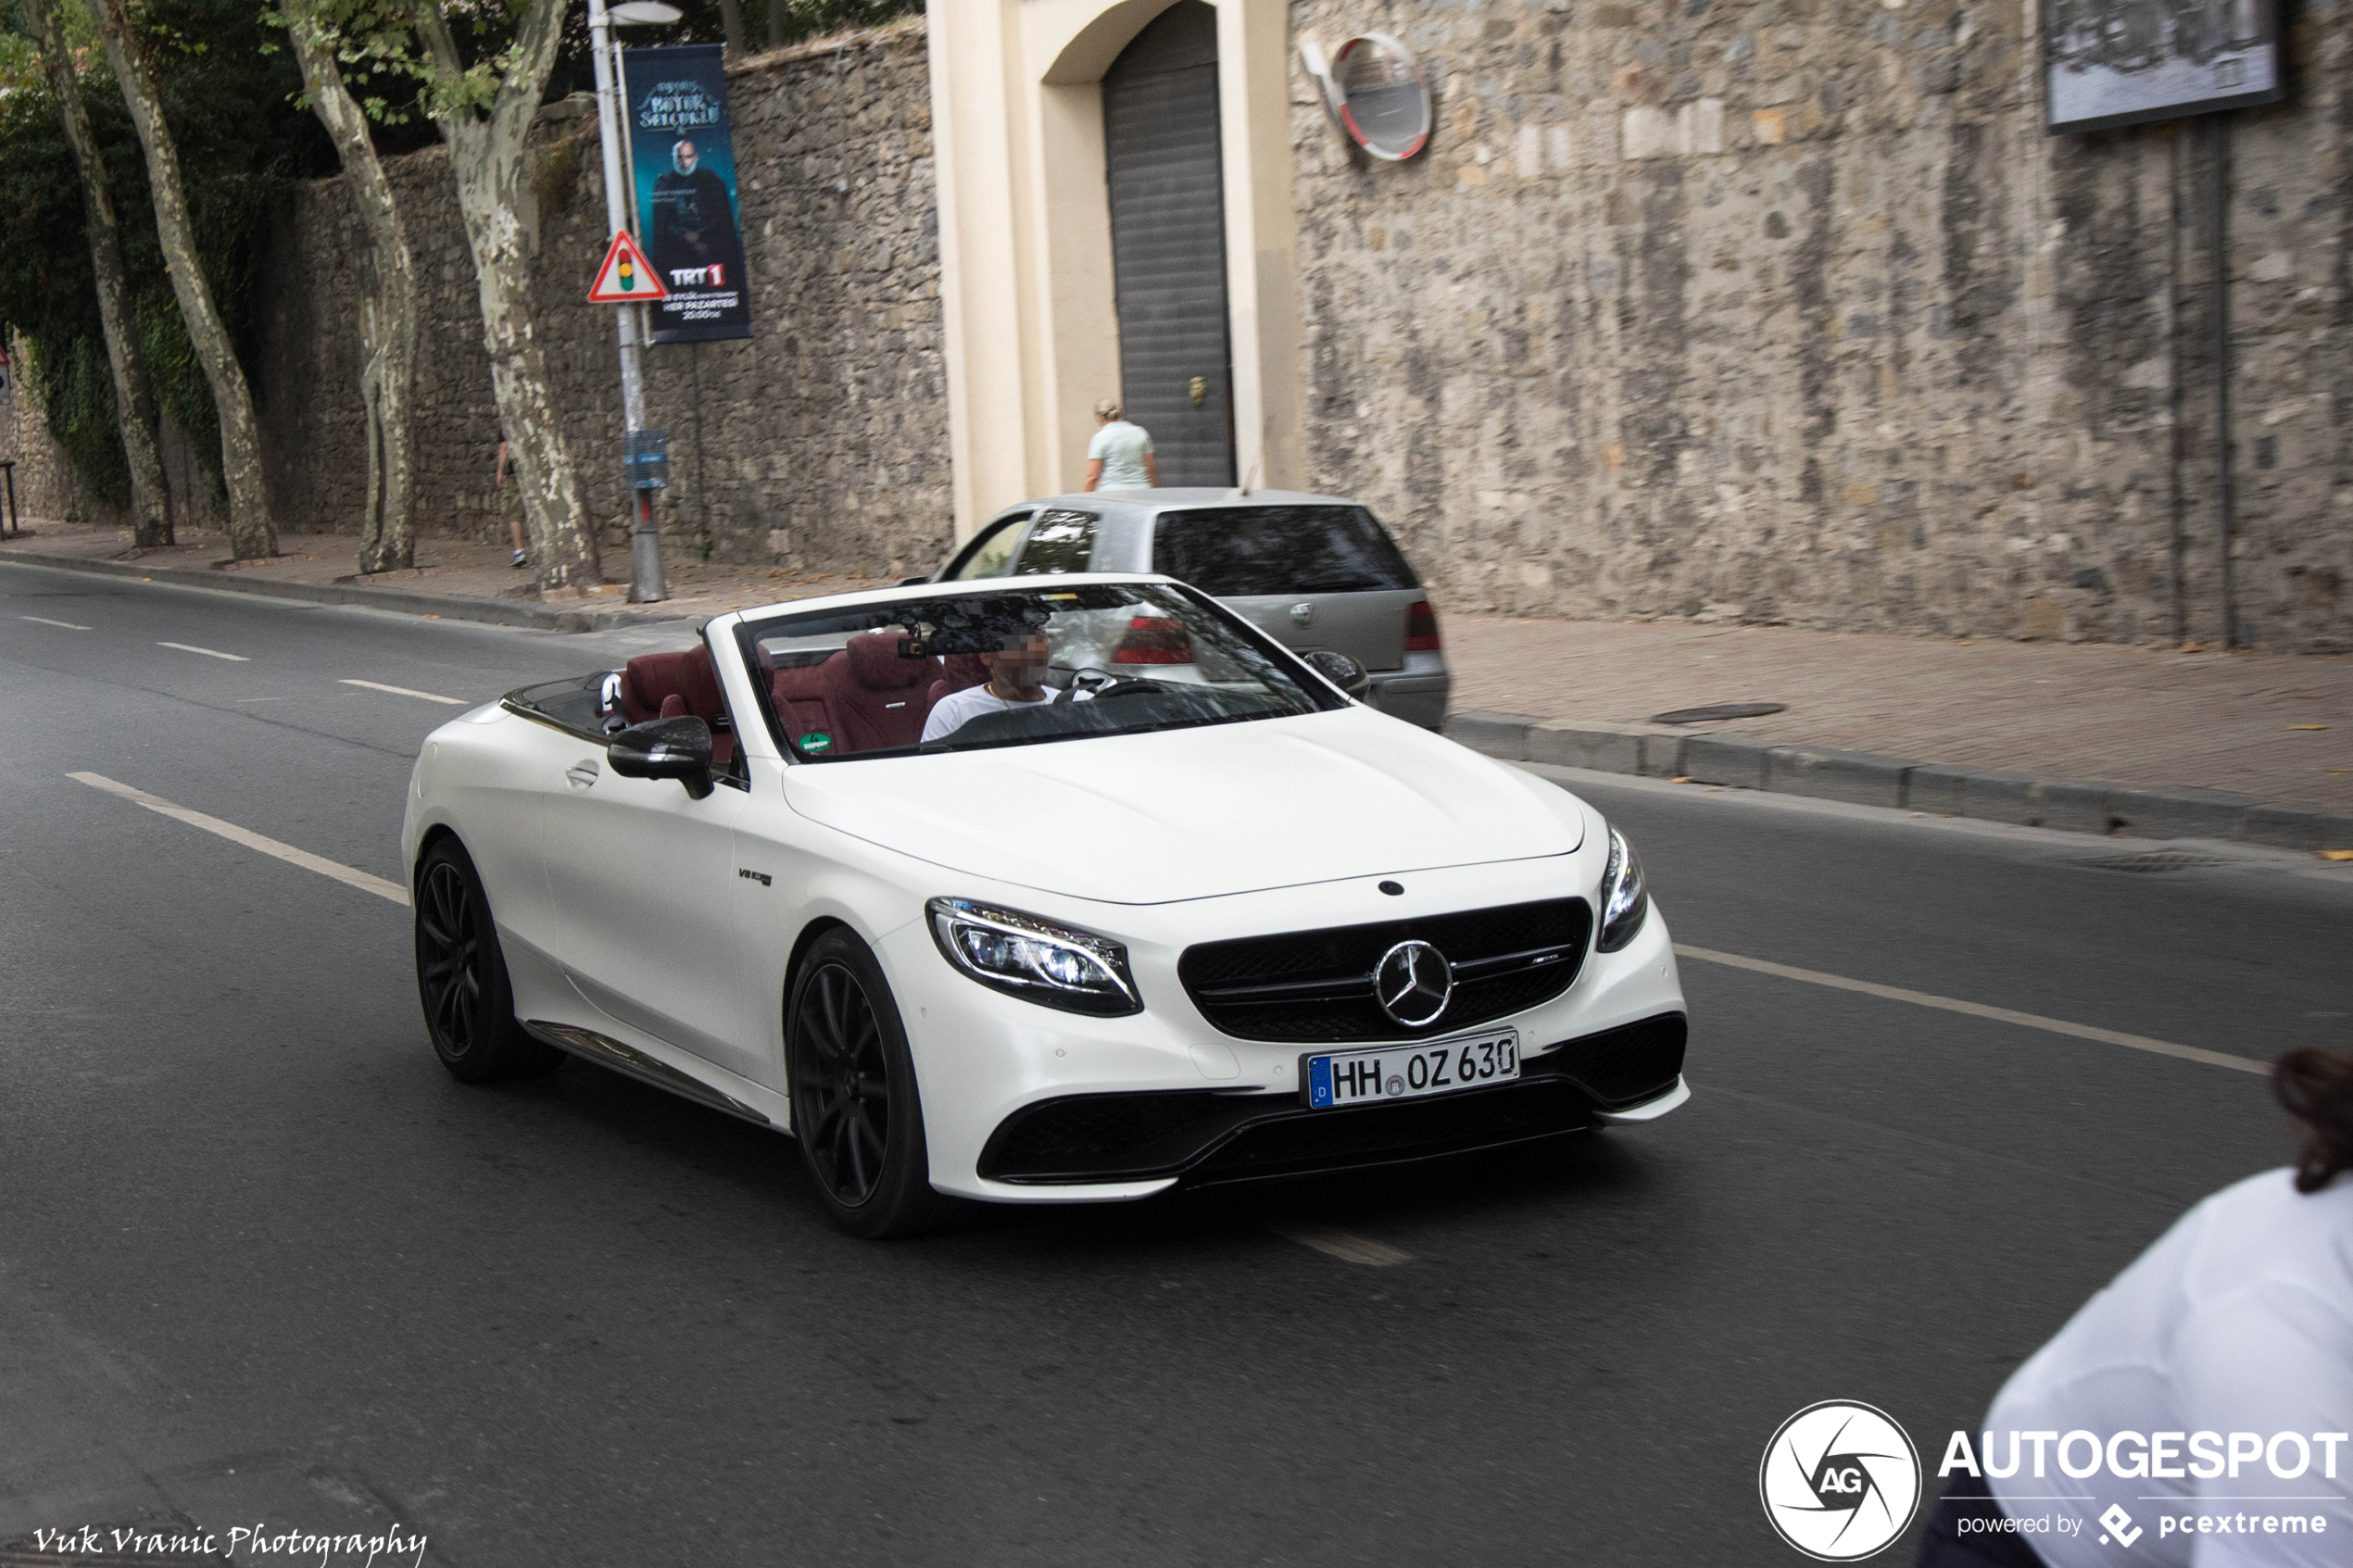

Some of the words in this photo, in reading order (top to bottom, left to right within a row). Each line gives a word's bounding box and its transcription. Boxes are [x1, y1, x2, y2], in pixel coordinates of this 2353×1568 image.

[663, 301, 685, 312] HER
[738, 868, 751, 879] V8
[1332, 1059, 1381, 1098] HH
[1407, 1049, 1451, 1089] OZ
[1458, 1038, 1516, 1082] 630
[1318, 1086, 1327, 1098] D
